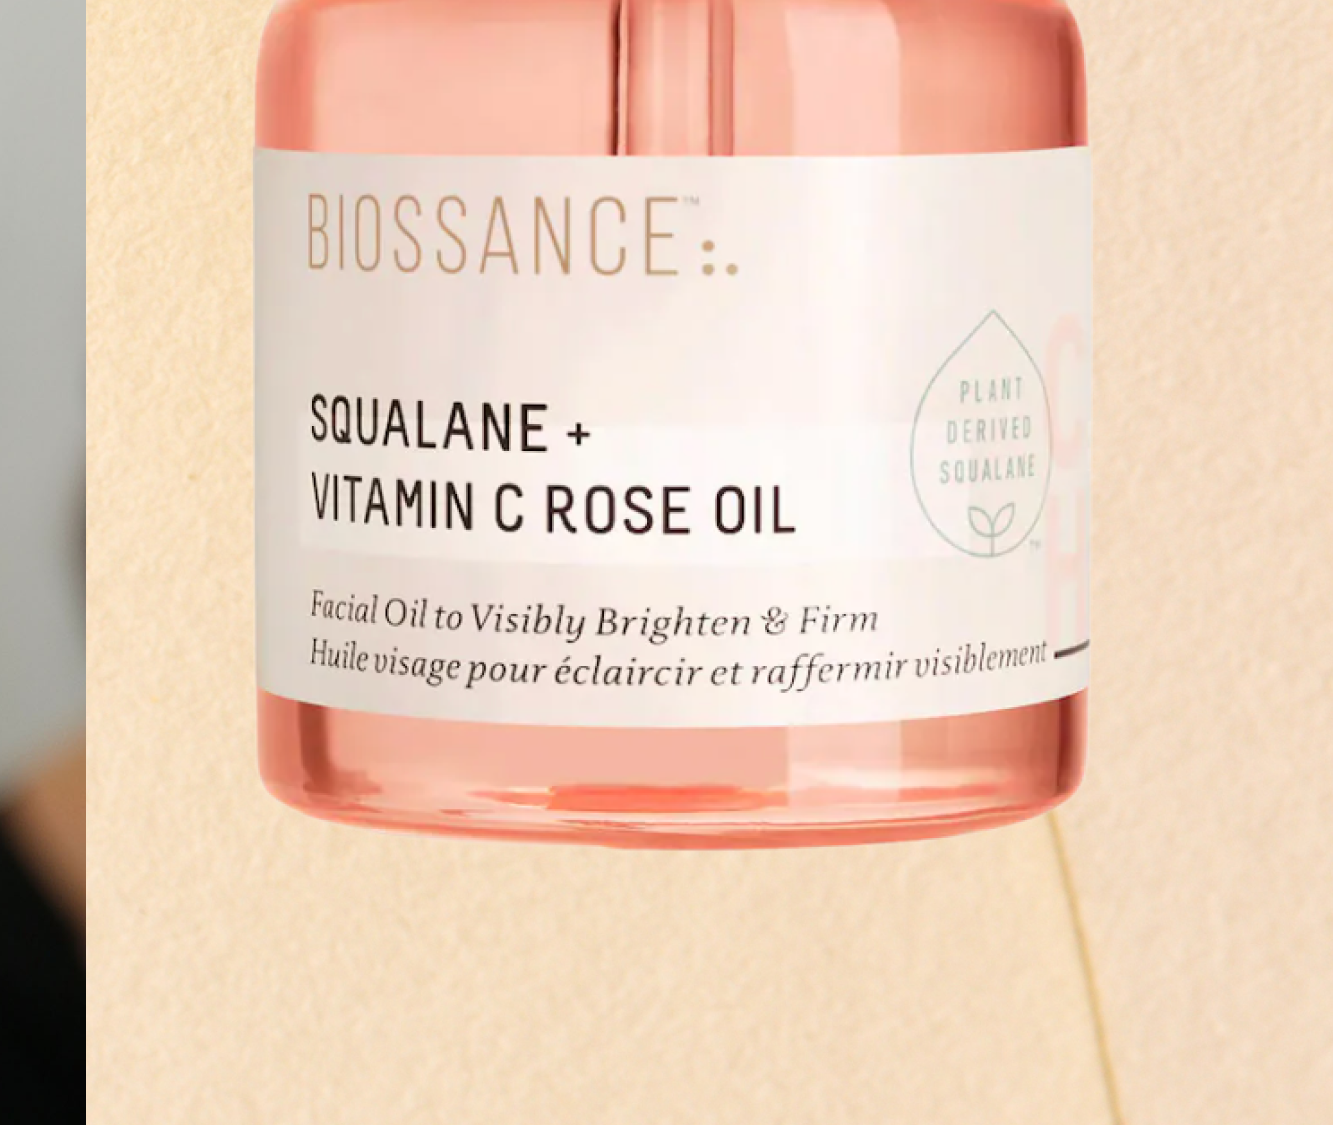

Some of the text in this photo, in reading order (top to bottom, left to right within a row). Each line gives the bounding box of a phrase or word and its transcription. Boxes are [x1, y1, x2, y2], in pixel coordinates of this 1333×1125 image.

[306, 191, 679, 277] BIOSSANCE
[958, 375, 1023, 405] PLANT
[310, 392, 592, 453] SQUALANE +
[946, 413, 1032, 446] DERIVED
[939, 452, 1036, 485] SQUALANE
[310, 470, 797, 536] VITAMIN C ROSE OIL
[310, 588, 879, 646] Facial Oil to Visibly Brighten & Firm
[310, 636, 1049, 695] Huile visage pour éclaircir et raffermir visiblement
